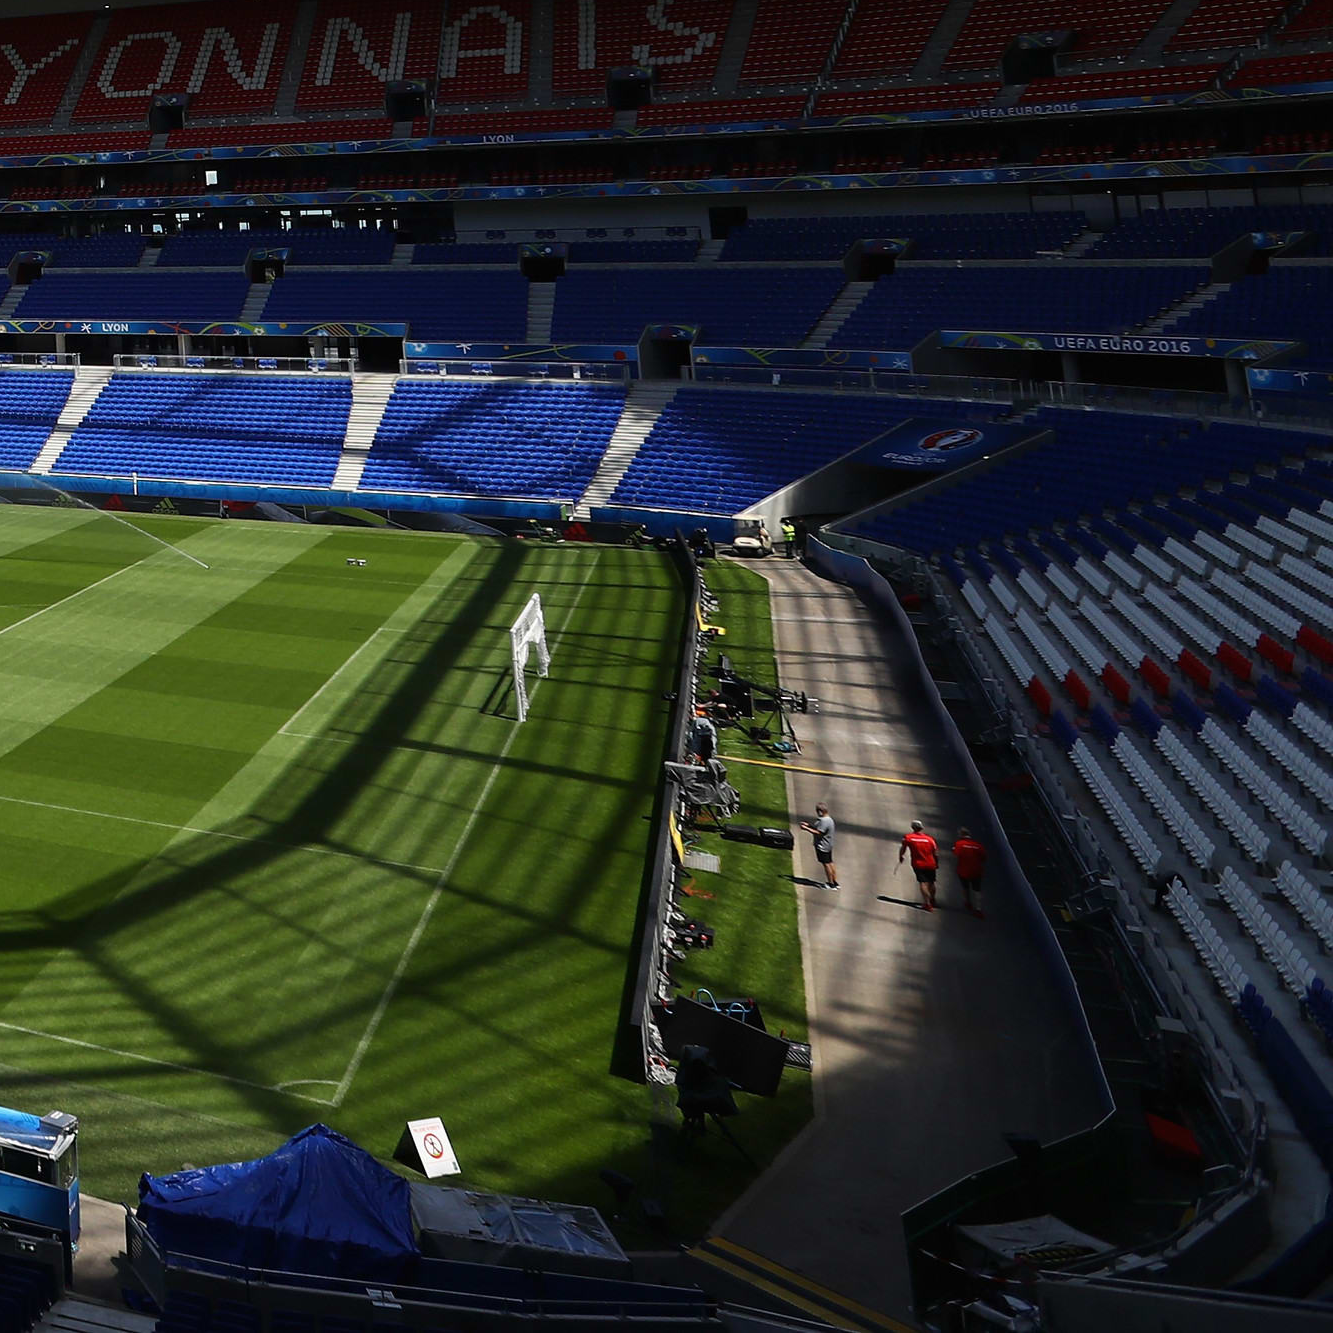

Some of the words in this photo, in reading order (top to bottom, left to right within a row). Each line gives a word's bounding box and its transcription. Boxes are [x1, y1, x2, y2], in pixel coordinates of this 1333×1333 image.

[969, 108, 1006, 118] UEFA
[1007, 105, 1043, 116] EURO
[1044, 103, 1079, 114] 2016
[482, 134, 514, 144] LYON
[102, 323, 129, 332] LYON
[1053, 337, 1096, 350] UEFA
[1099, 338, 1144, 352] EURO
[1148, 340, 1191, 353] 2016
